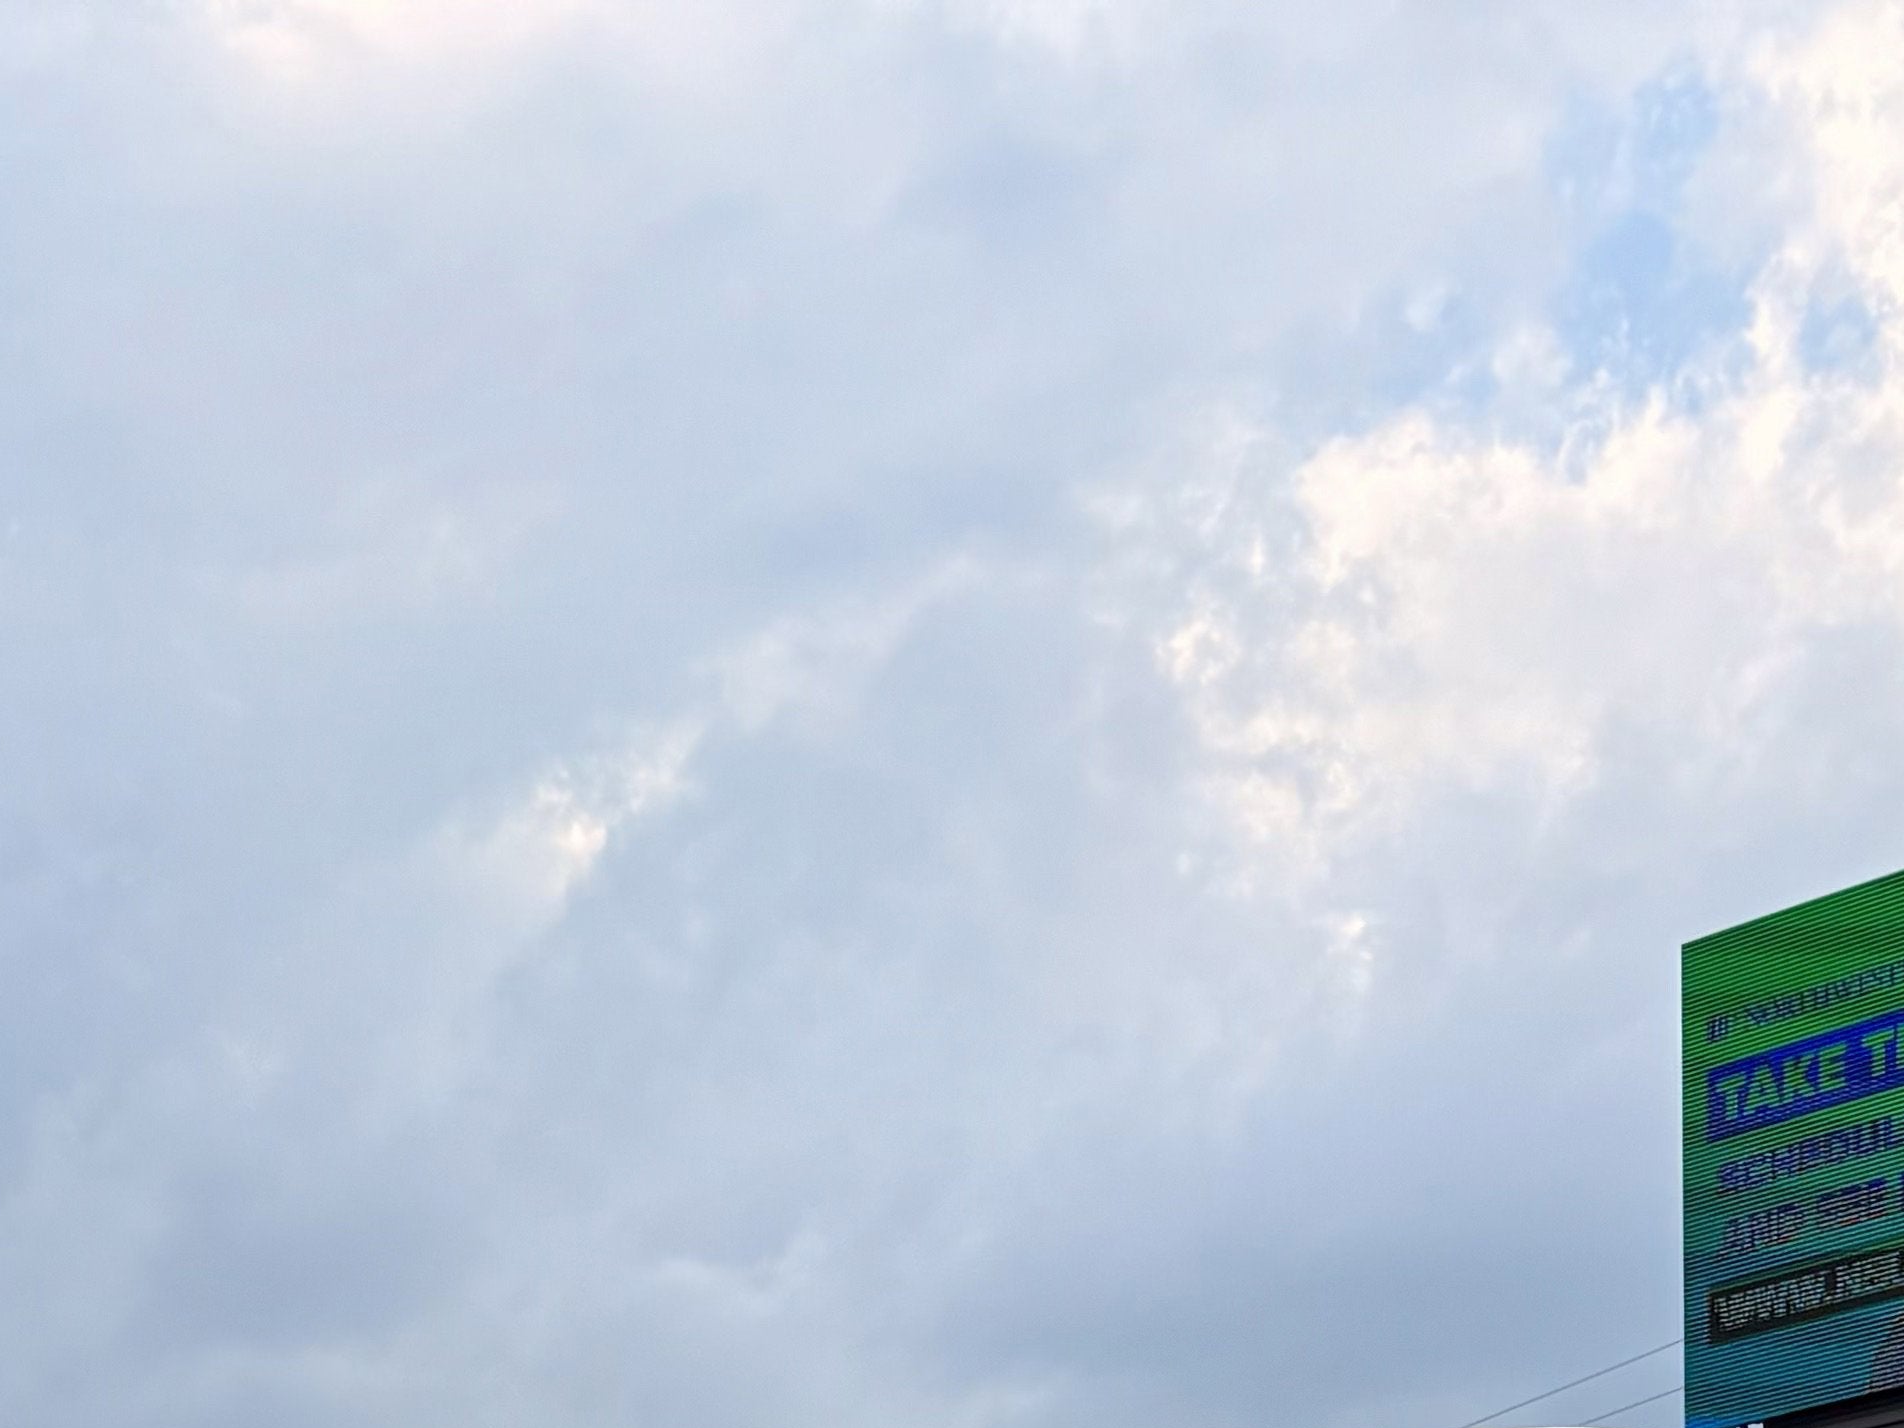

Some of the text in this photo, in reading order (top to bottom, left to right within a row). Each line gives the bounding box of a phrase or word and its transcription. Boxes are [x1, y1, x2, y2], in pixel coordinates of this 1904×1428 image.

[1716, 1044, 1847, 1121] TAKE
[1718, 1202, 1805, 1258] AND
[1816, 1177, 1888, 1230] SEE
